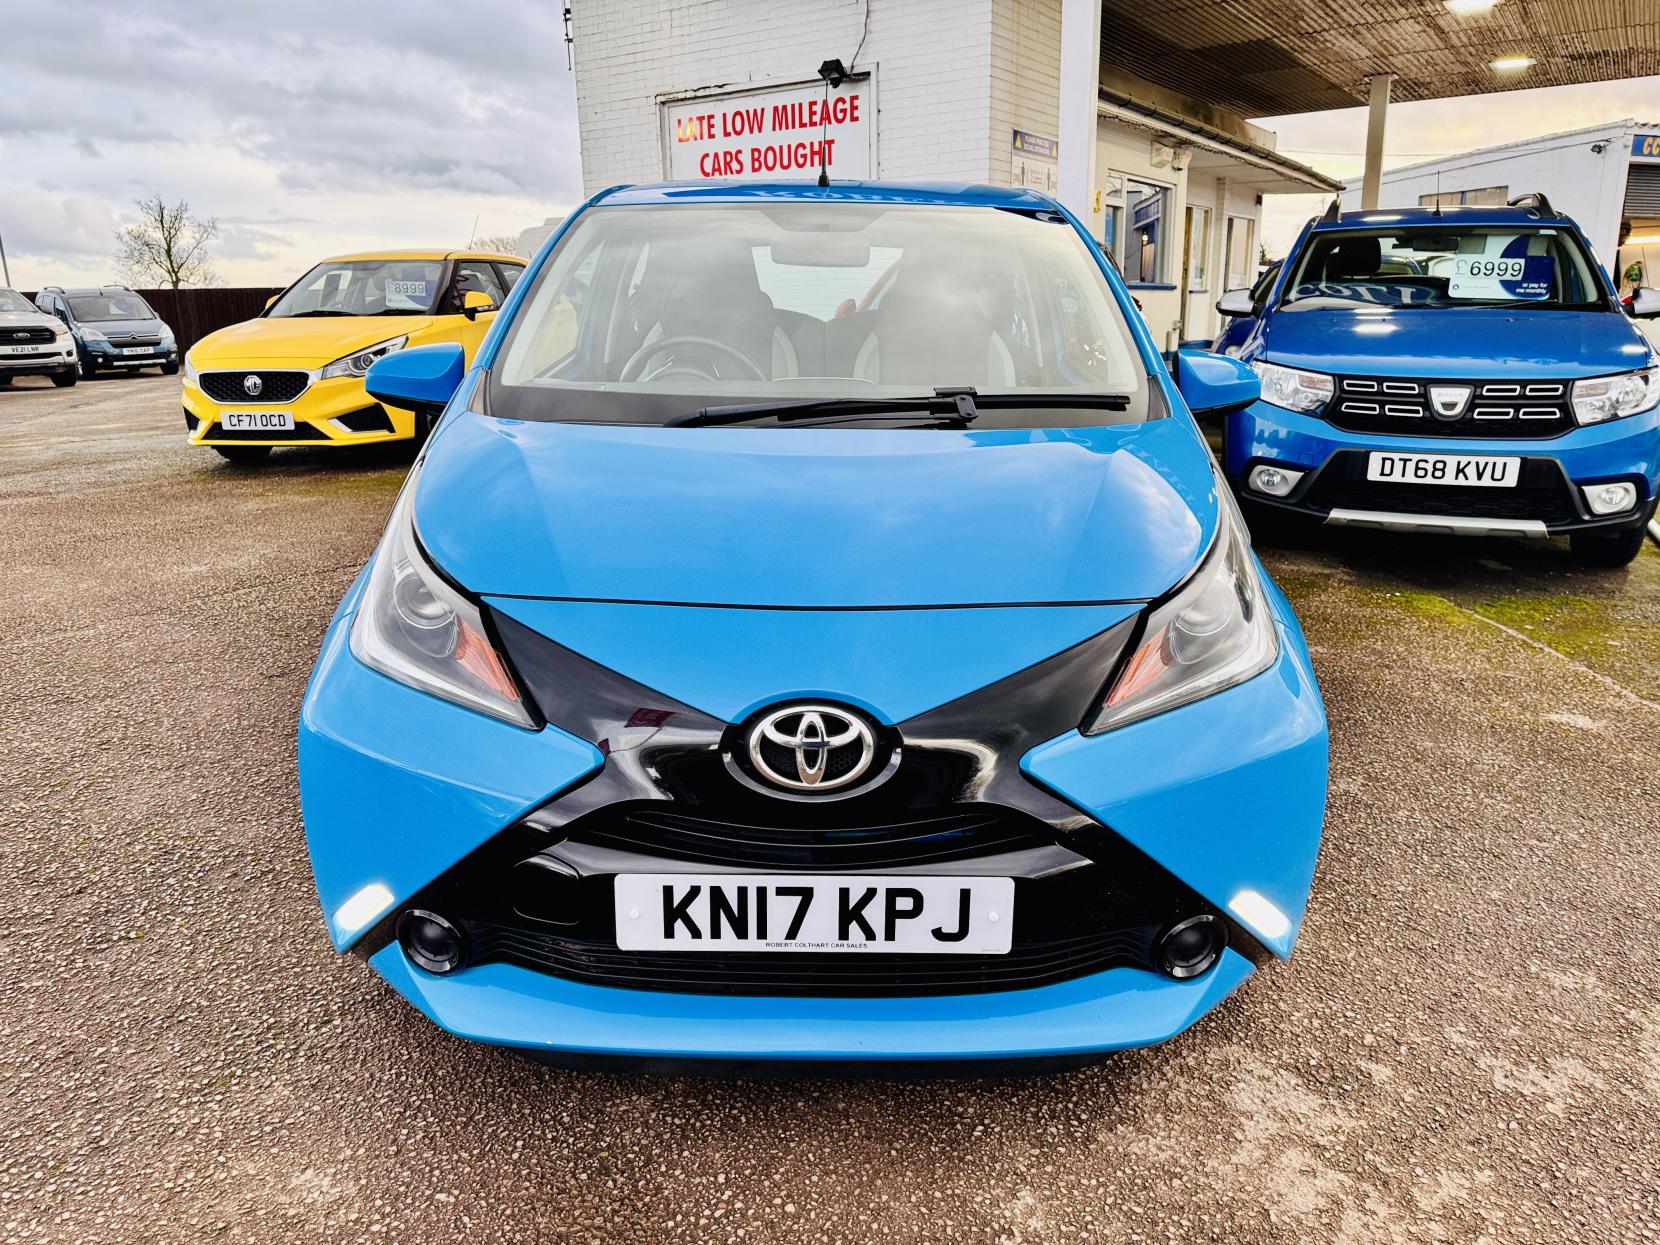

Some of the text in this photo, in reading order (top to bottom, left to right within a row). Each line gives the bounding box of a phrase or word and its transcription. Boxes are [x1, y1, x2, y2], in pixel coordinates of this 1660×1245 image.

[677, 95, 860, 143] LATE LOW MILEAGE
[699, 139, 835, 177] CARS BOUGHT
[228, 414, 286, 427] CF71 OCD
[1379, 456, 1508, 482] DT68 KVU
[662, 884, 971, 943] KN17 KPJ
